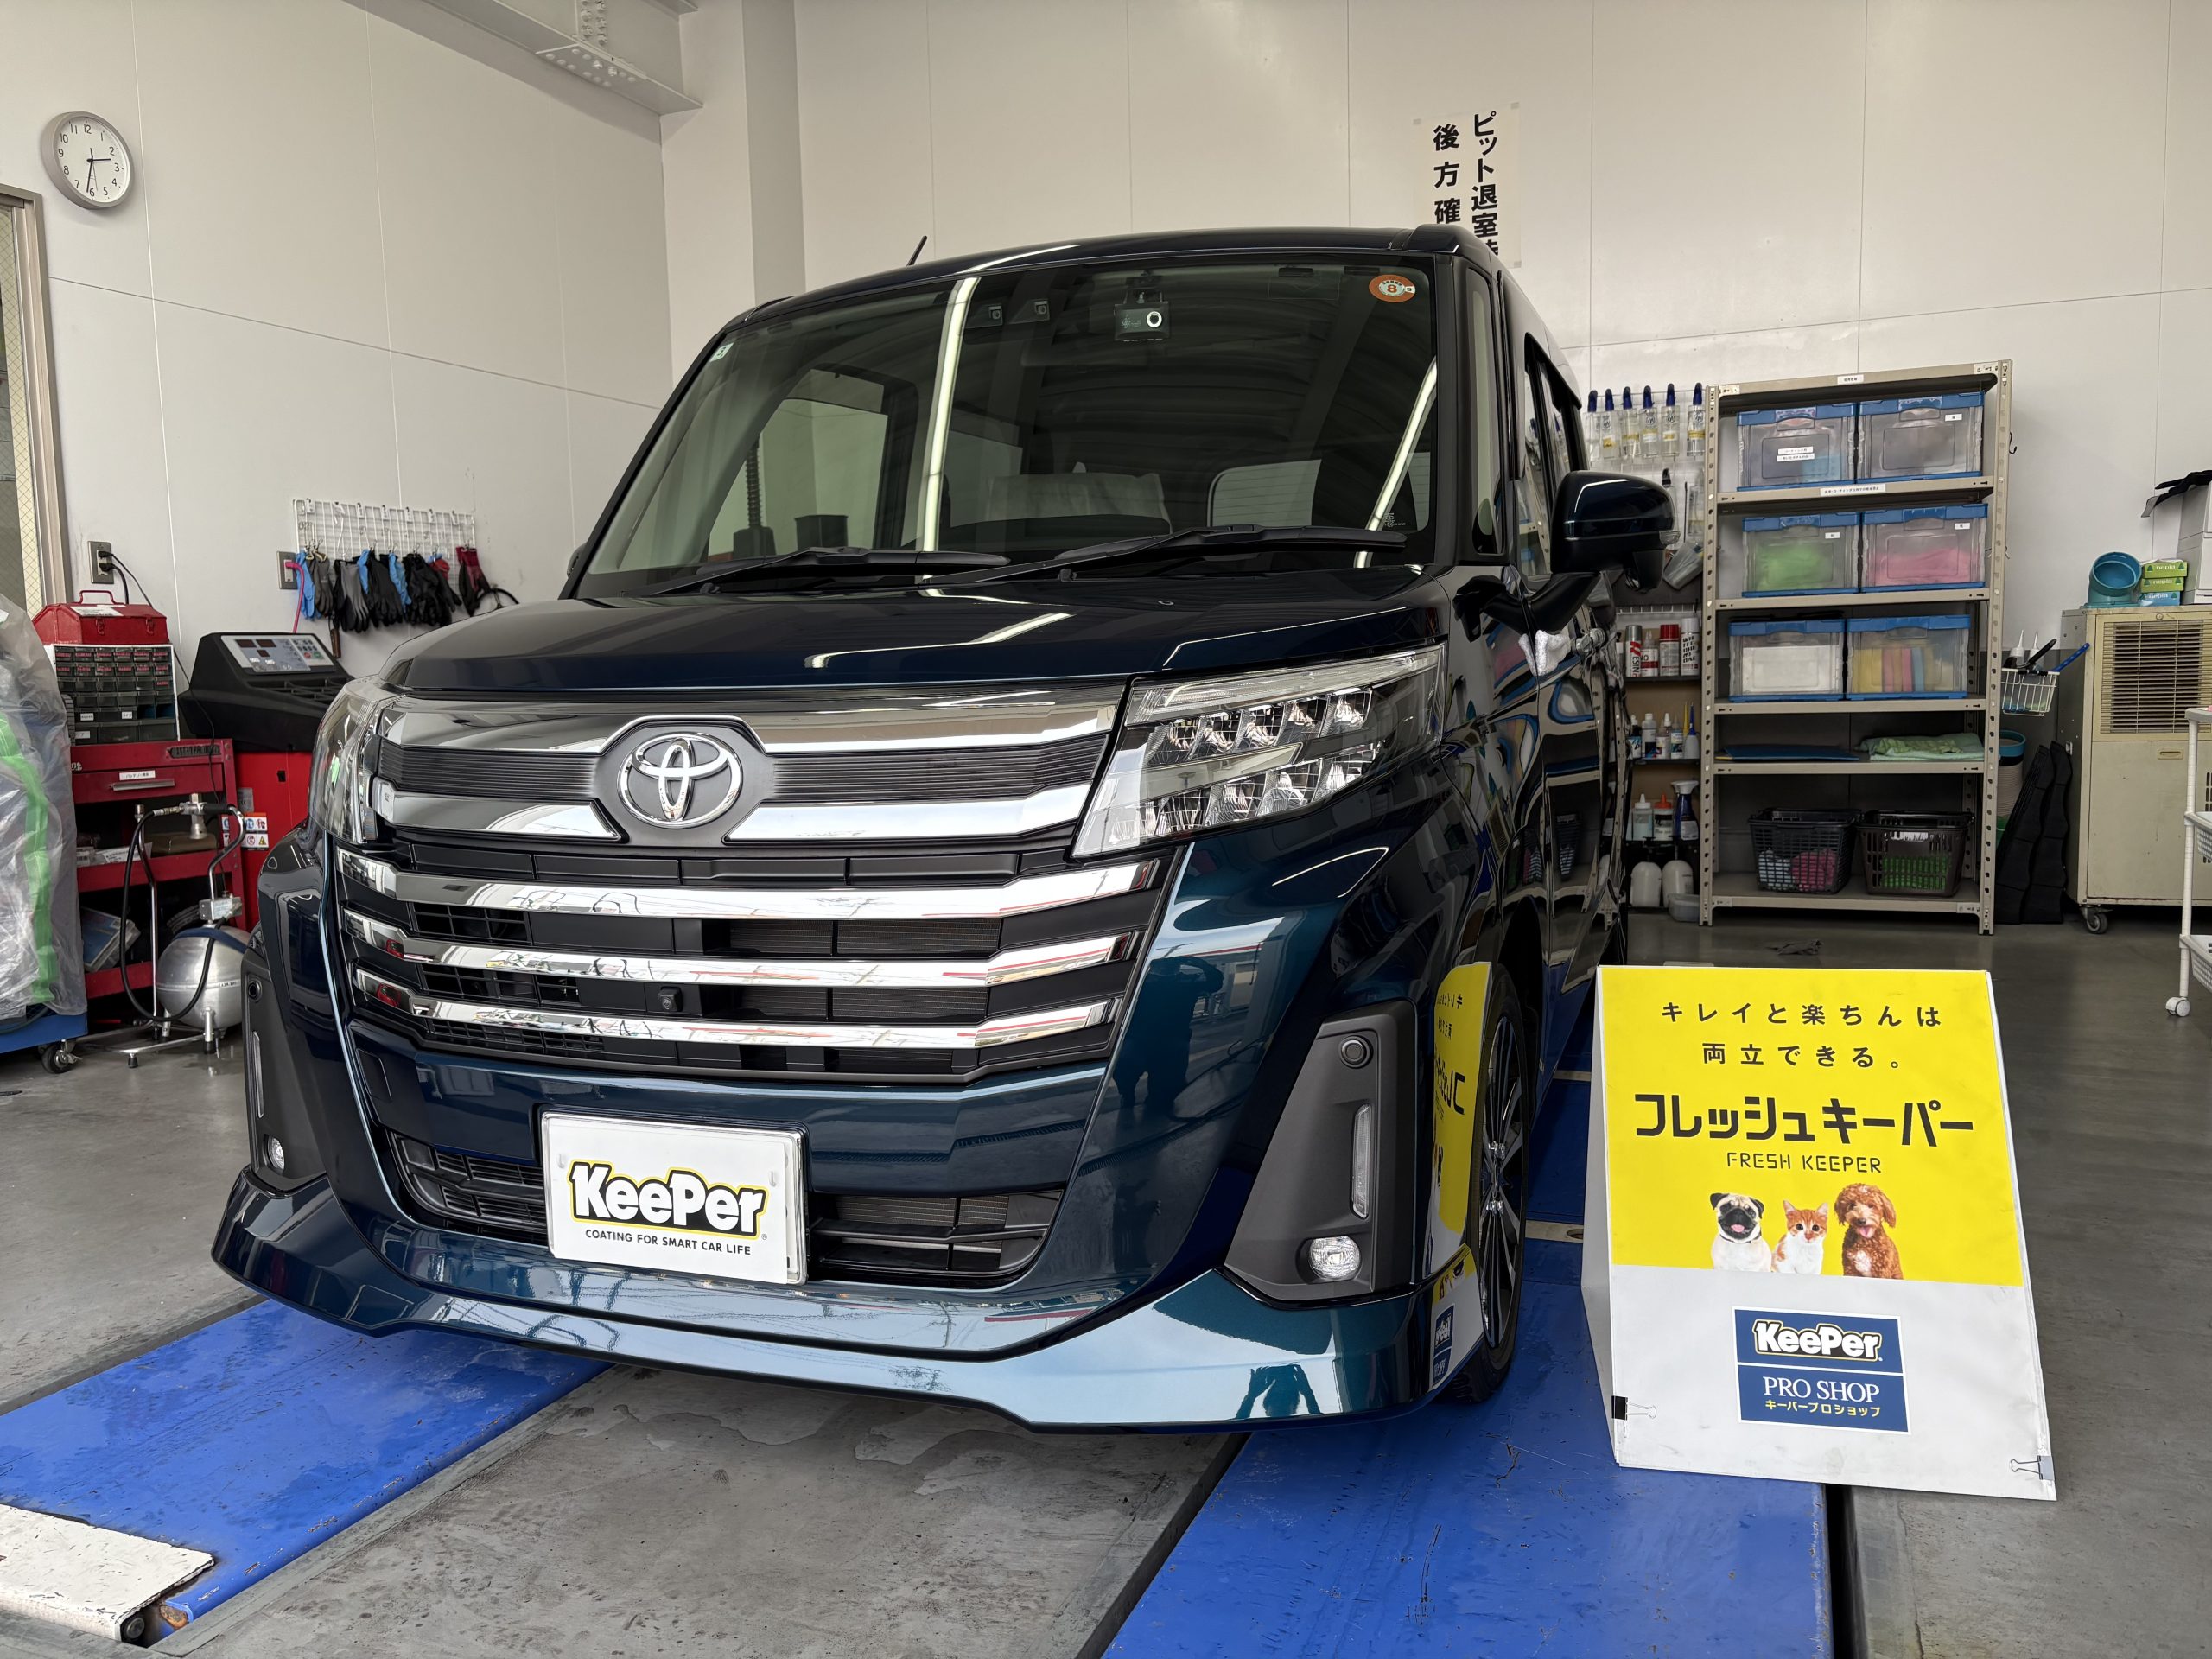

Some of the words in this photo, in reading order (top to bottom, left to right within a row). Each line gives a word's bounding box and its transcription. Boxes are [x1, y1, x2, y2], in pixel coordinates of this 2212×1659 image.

[70, 124, 78, 134] 11
[84, 124, 92, 134] 12
[60, 132, 68, 143] 10
[58, 148, 64, 157] 9
[109, 146, 115, 156] 2
[63, 165, 69, 175] 8
[114, 162, 119, 172] 3
[74, 179, 79, 188] 7
[111, 178, 117, 187] 4
[89, 188, 95, 196] 6
[103, 186, 108, 195] 5
[1387, 284, 1397, 293] 8
[1661, 1001, 1942, 1027] キレイと楽ちんは
[1701, 1042, 1900, 1070] 両立できる。
[1634, 1093, 1974, 1147] フレッシュキーパー
[1726, 1152, 1791, 1170] FRESH
[1802, 1154, 1882, 1173] KEEPER
[569, 1161, 767, 1237] KeePer
[585, 1229, 632, 1243] COATING
[637, 1234, 658, 1245] FOR
[662, 1238, 697, 1249] SMART
[701, 1241, 722, 1252] CAR
[726, 1243, 751, 1255] LIFE
[1754, 1320, 1882, 1360] KeePer
[1763, 1376, 1811, 1399] PRO
[1816, 1380, 1880, 1403] SHOP
[1764, 1399, 1881, 1418] キーパープロショップ
